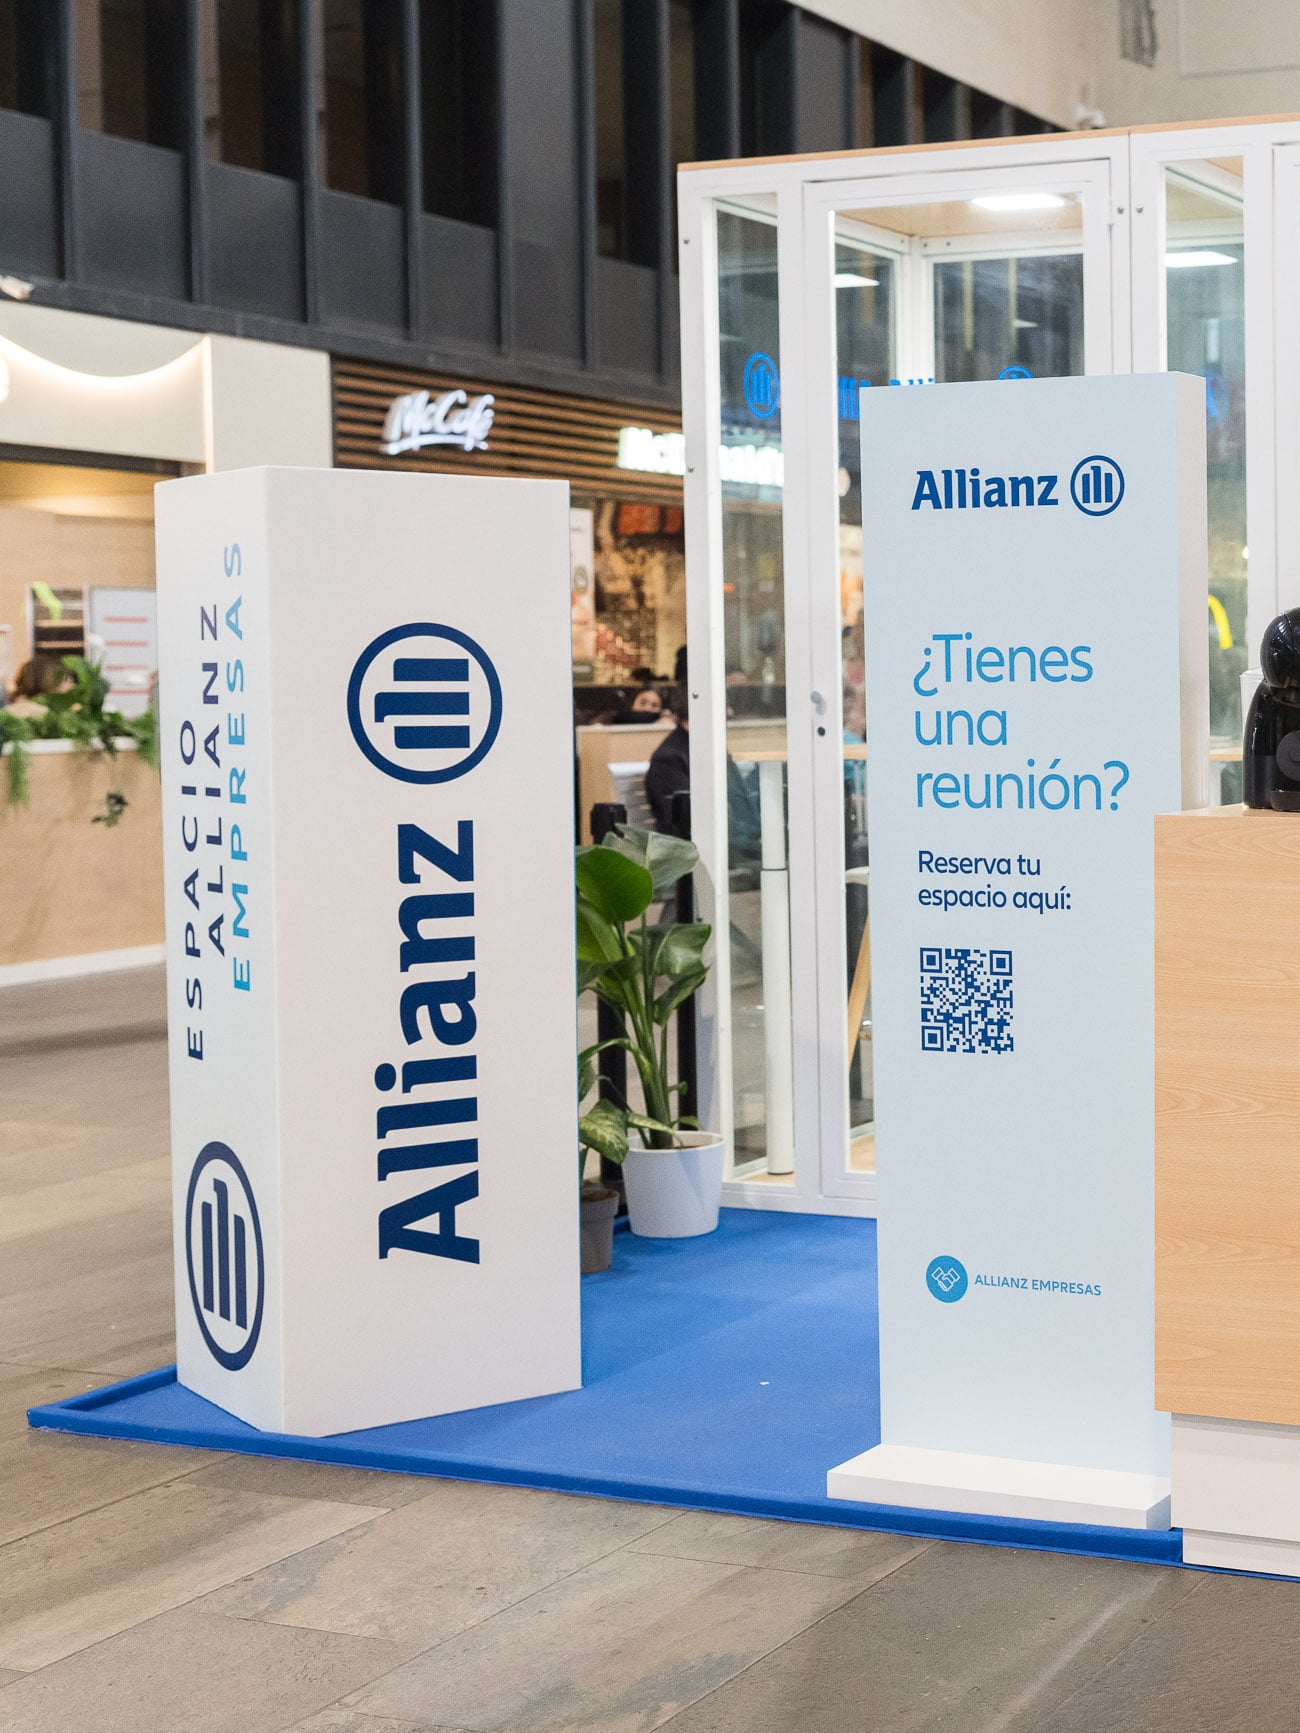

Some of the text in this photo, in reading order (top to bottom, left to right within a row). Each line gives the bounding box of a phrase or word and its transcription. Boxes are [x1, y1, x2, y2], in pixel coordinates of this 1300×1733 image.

[911, 468, 1058, 510] Allianz
[913, 632, 1093, 697] ¿Tienes
[915, 710, 1007, 747] una
[200, 604, 226, 957] ALLIANZ
[223, 543, 251, 992] EMPRESAS
[917, 757, 1130, 812] reunión?
[918, 849, 1041, 876] Reserva tu
[180, 720, 204, 1061] ESPACIO
[918, 884, 1072, 915] espacio aquí:
[375, 820, 480, 1264] Allianz
[974, 1274, 1102, 1297] ALLIANZ EMPRESAS
